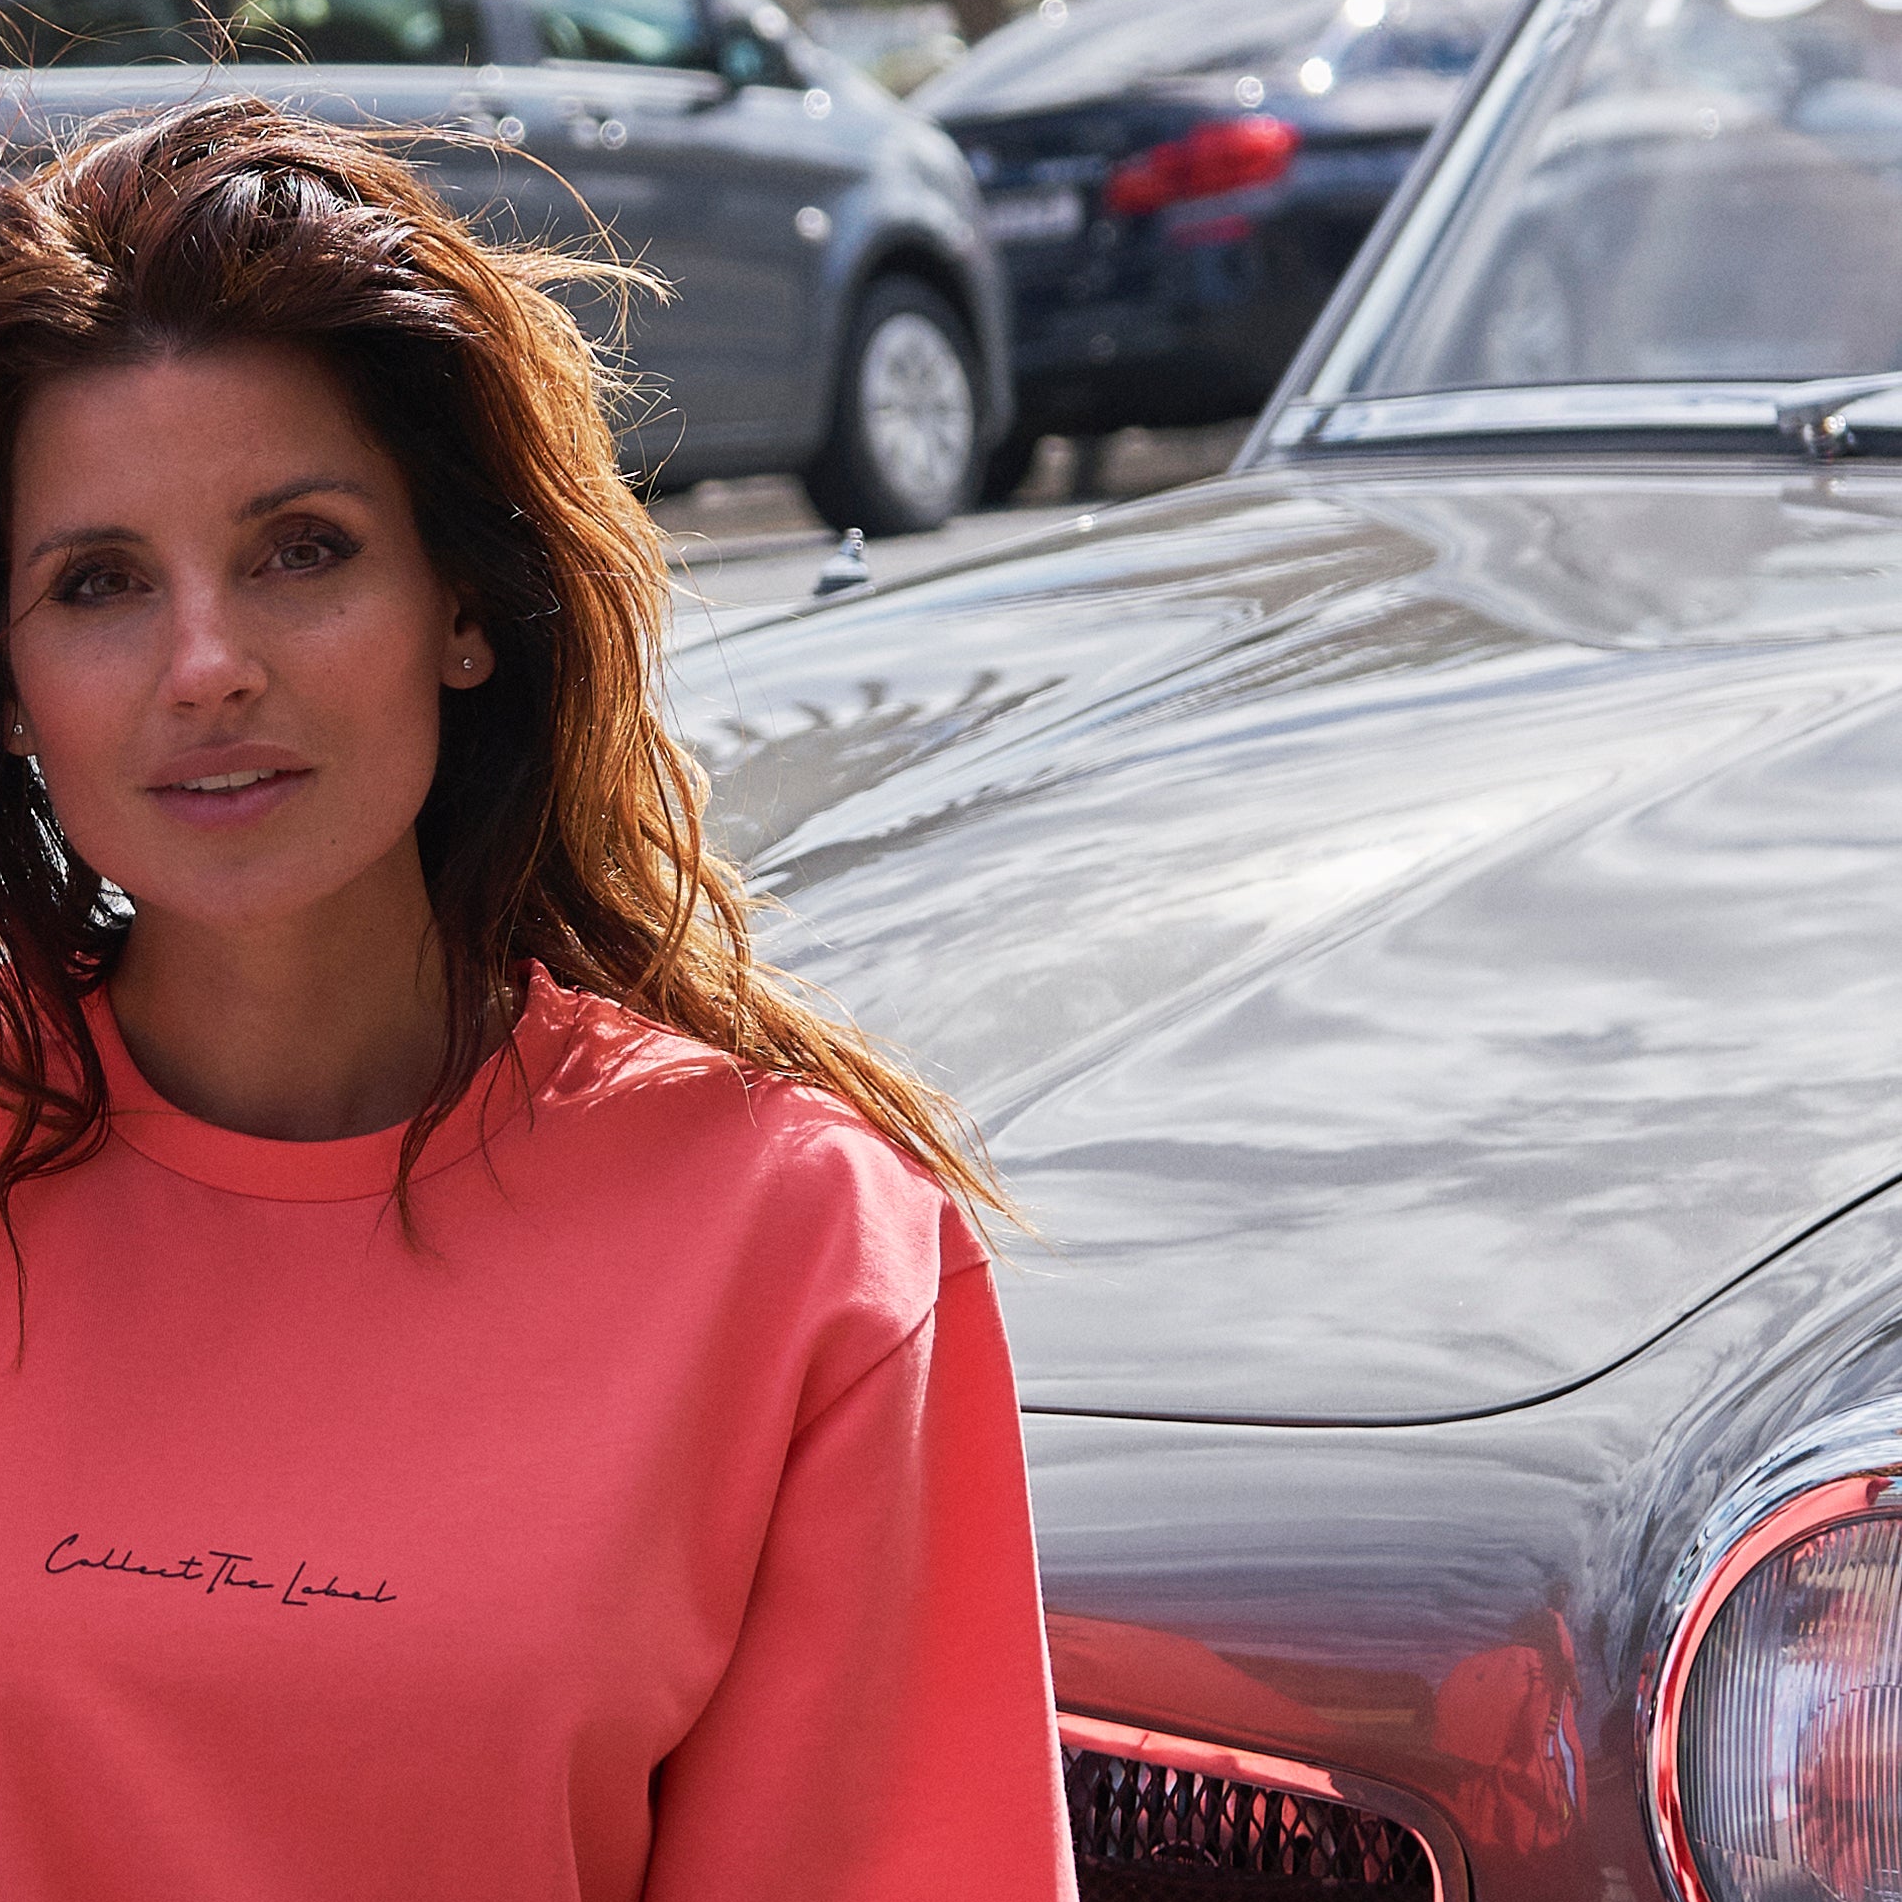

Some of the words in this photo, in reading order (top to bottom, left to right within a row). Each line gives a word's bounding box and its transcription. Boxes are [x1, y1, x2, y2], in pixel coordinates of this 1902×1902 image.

[44, 1533, 203, 1580] Collect
[206, 1550, 274, 1595] The
[282, 1561, 397, 1607] Label
